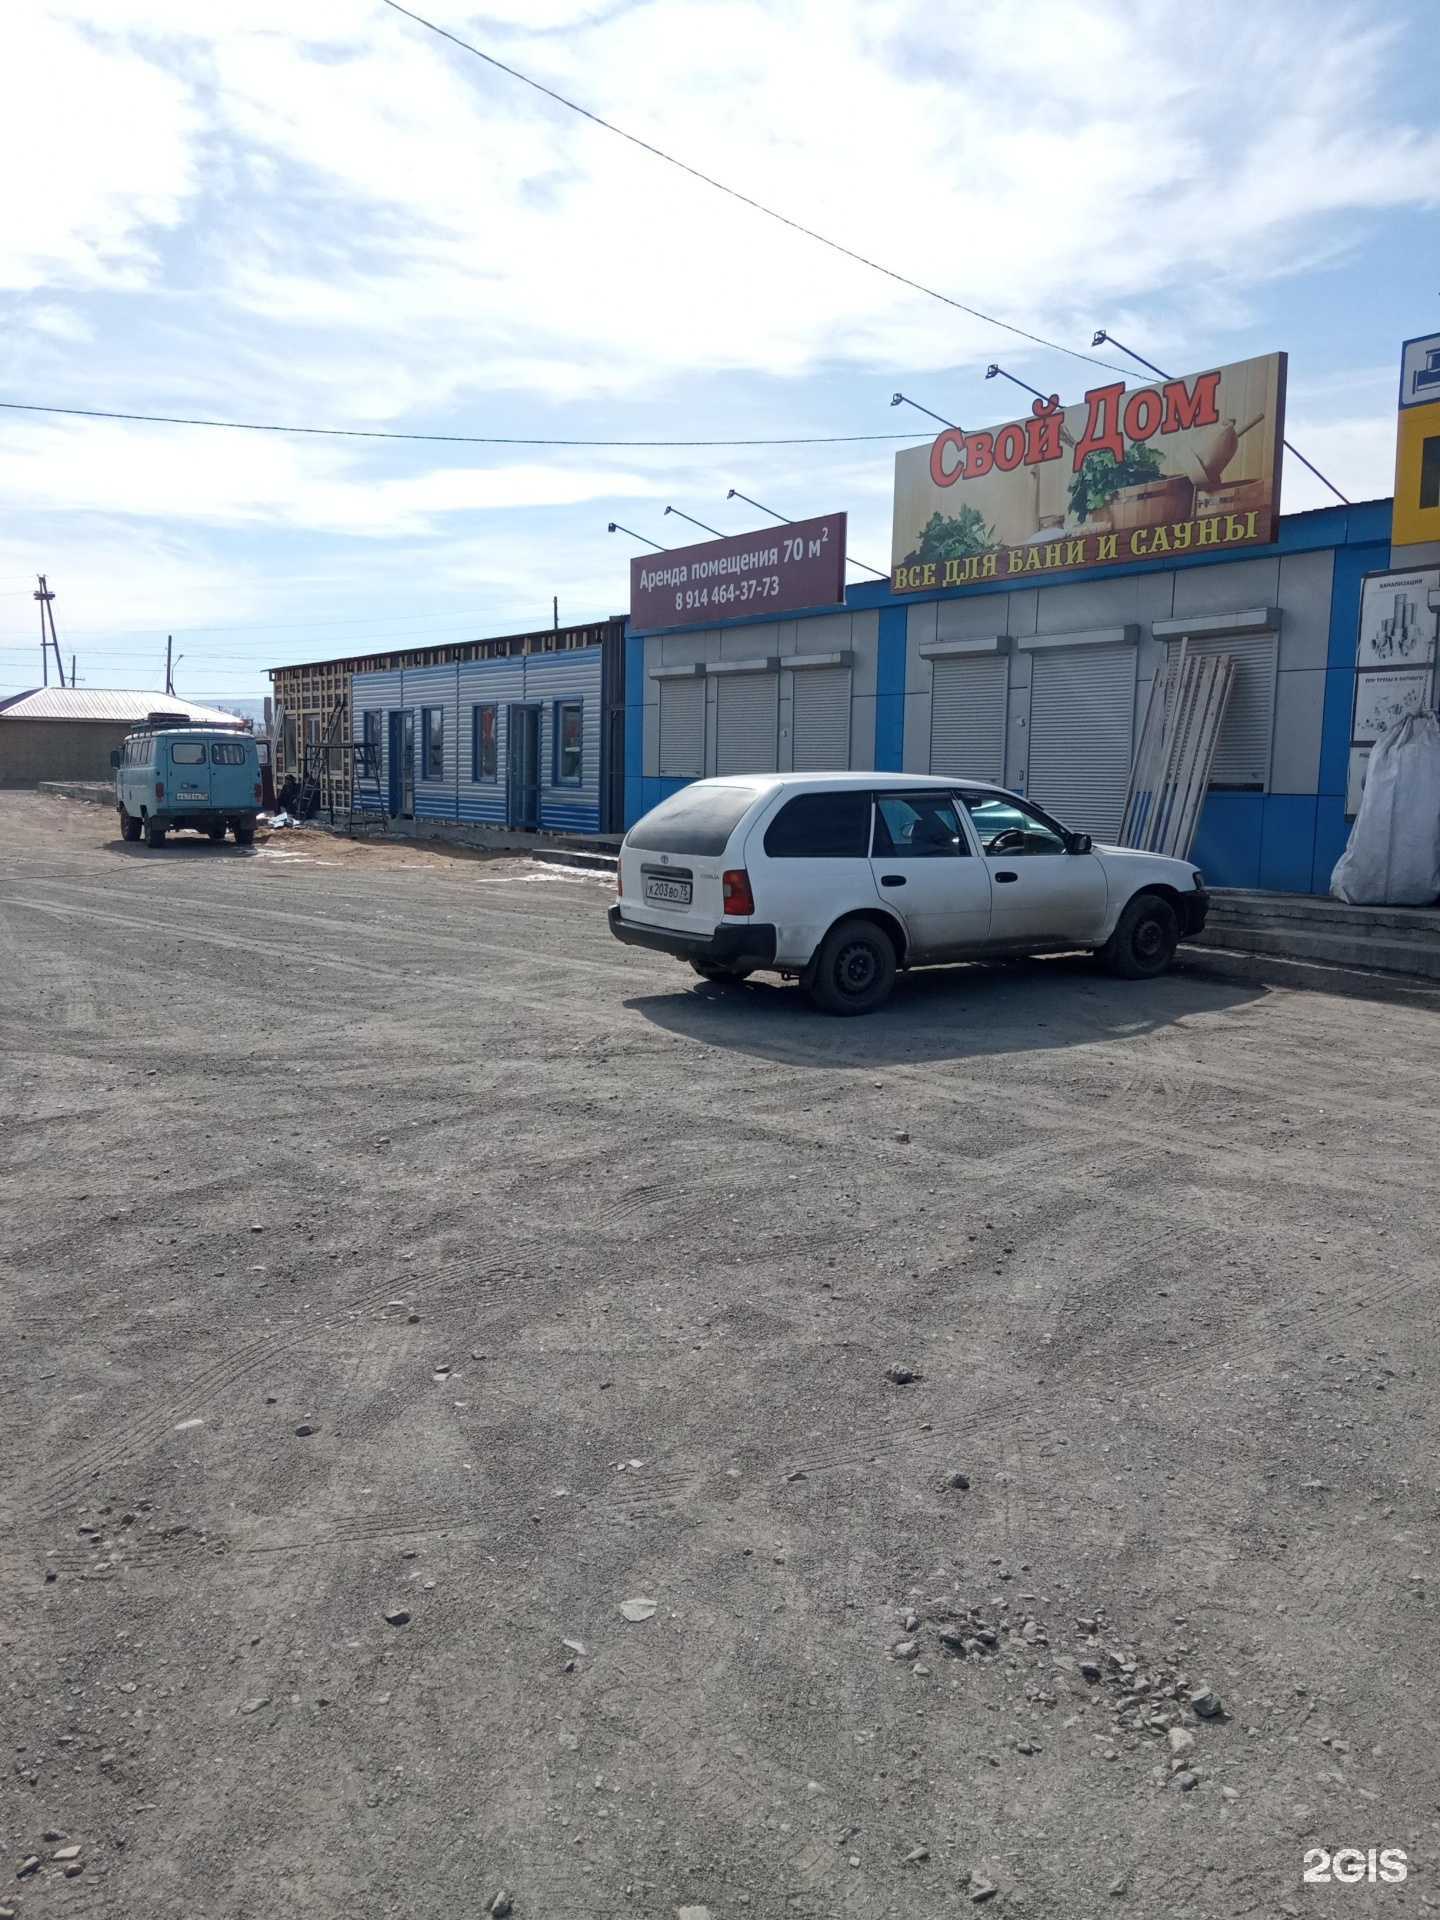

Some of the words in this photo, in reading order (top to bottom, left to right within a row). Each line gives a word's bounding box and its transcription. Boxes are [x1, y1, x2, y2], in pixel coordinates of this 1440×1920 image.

[929, 394, 1064, 487] Свой
[1073, 371, 1221, 472] Дом
[639, 564, 688, 592] Аренда
[690, 548, 778, 578] помещения
[783, 537, 803, 563] 70
[894, 564, 936, 589] ВСЕ
[942, 554, 998, 588] ДЛЯ
[1007, 539, 1086, 574] БАНИ
[1097, 532, 1119, 561] И
[1130, 511, 1260, 555] САУНЫ
[675, 592, 683, 610] 8
[686, 588, 709, 609] 914
[711, 575, 780, 604] 464-37-73
